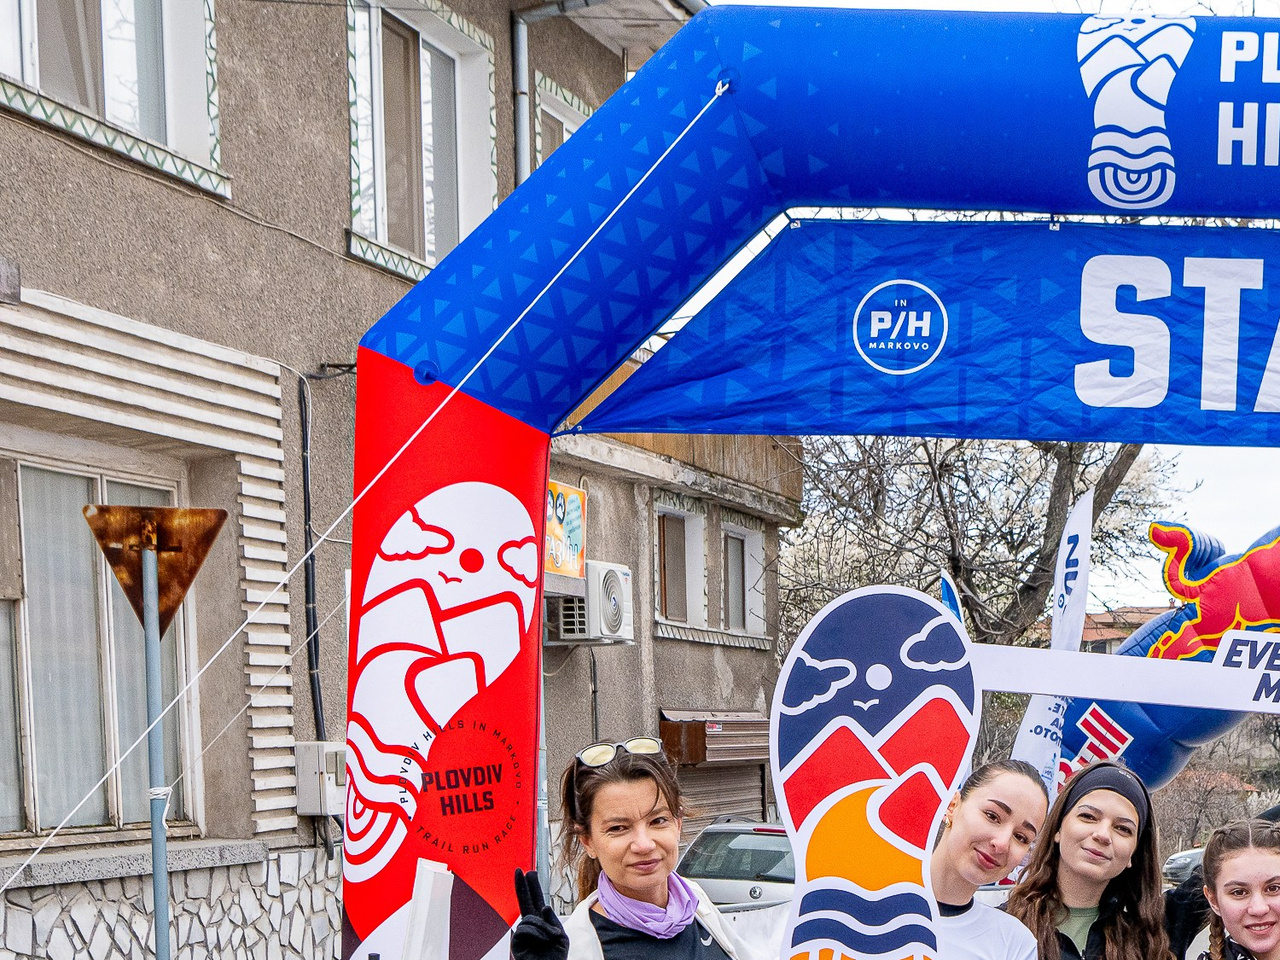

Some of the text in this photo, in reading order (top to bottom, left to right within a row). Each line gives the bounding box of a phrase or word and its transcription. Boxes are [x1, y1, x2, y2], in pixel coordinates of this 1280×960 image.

[894, 299, 907, 307] IN
[870, 310, 932, 340] P/H
[868, 341, 930, 351] MARKOVO
[398, 720, 522, 804] PLOVDIV HILLS IN MARKOVO
[420, 763, 502, 793] PLOVDIV
[440, 790, 495, 817] HILLS
[416, 814, 516, 854] TRAIL RUN RACE
